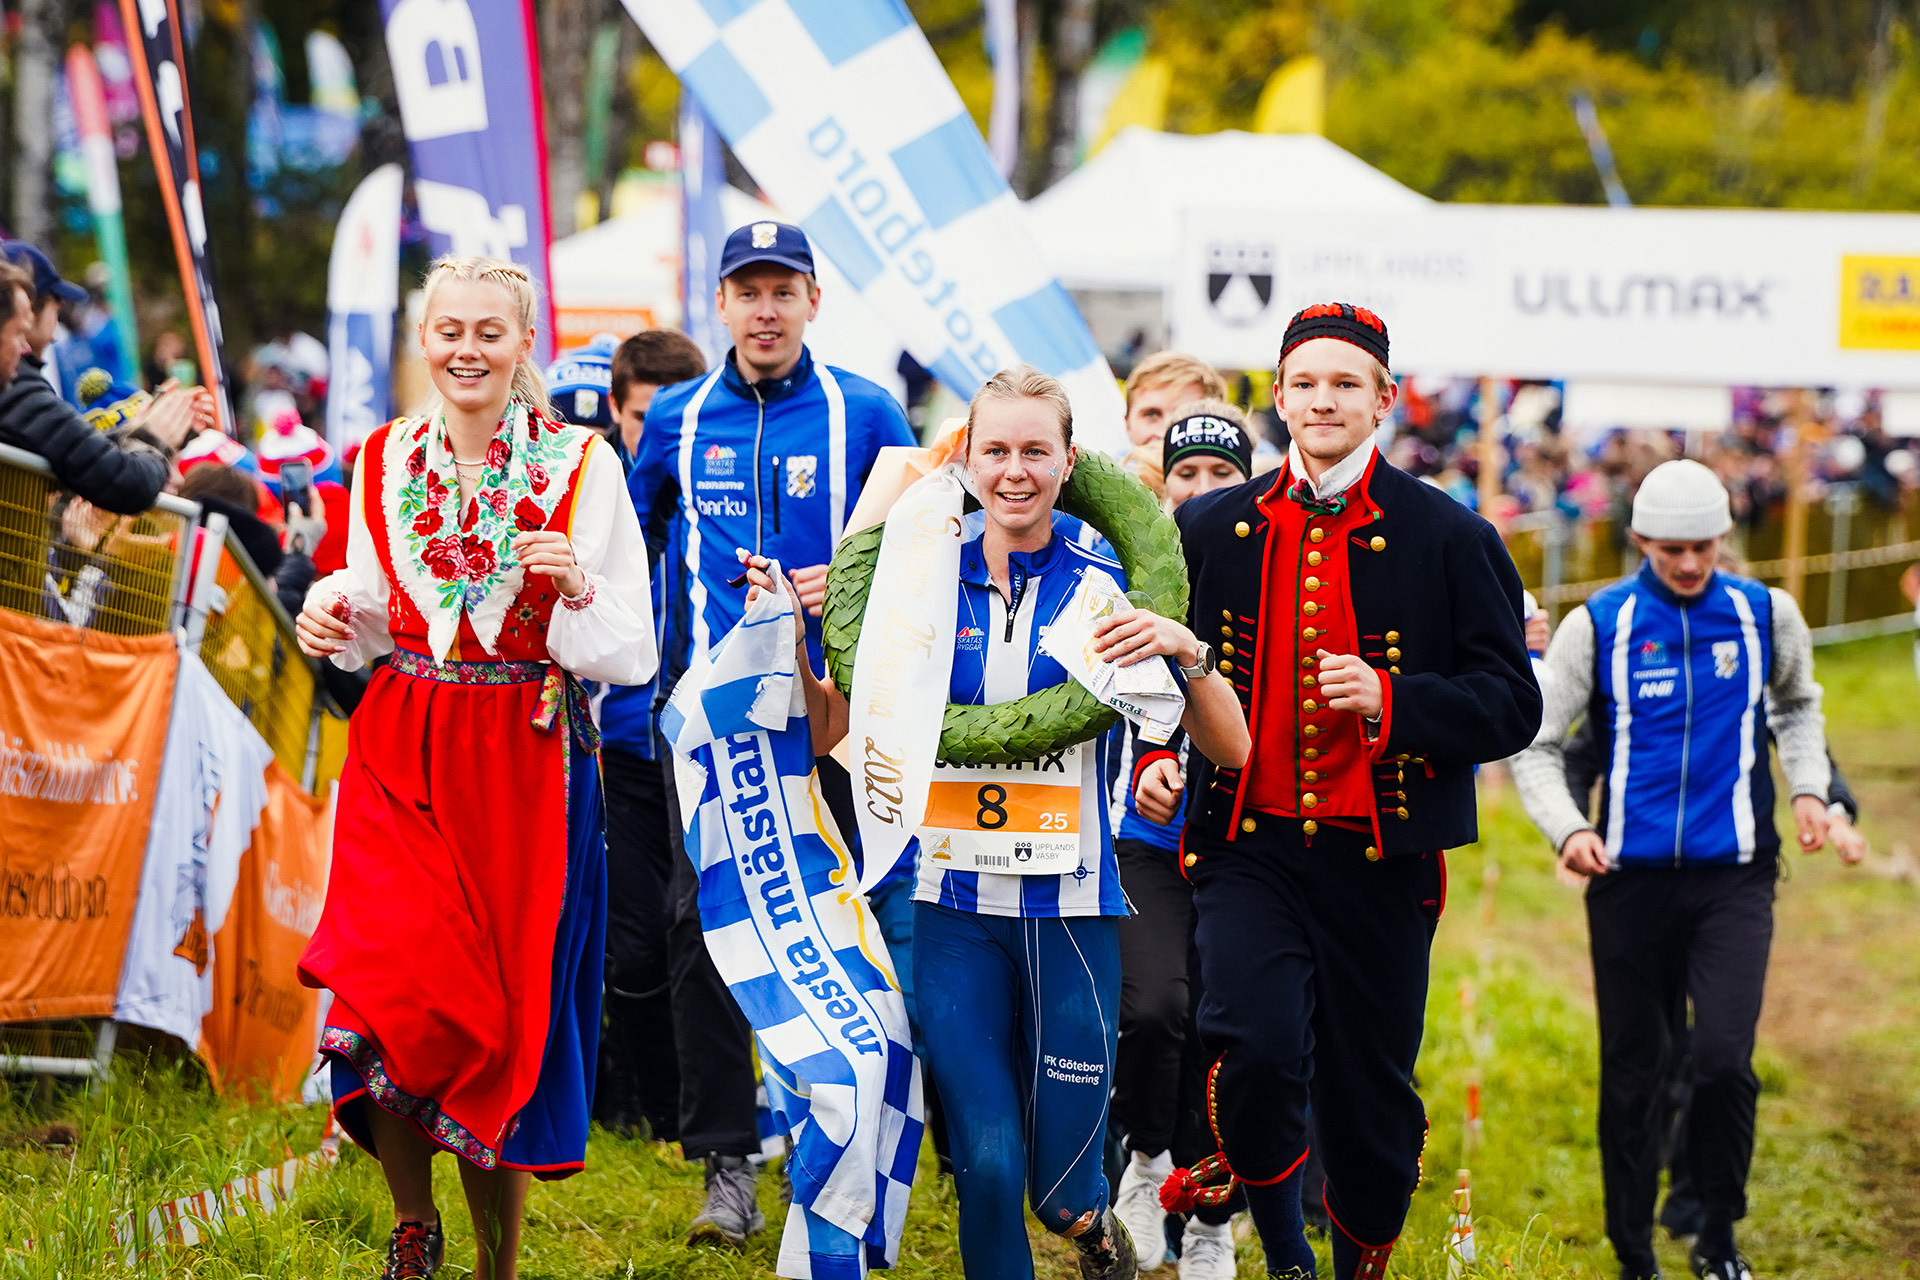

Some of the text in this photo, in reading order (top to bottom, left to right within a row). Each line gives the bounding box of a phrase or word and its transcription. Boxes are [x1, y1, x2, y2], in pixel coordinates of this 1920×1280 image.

[1513, 270, 1770, 319] ULLMAX
[1170, 416, 1240, 447] LEDX
[696, 480, 745, 490] noname
[696, 495, 747, 516] barku
[1109, 697, 1144, 716] PEAB
[863, 735, 906, 828] 2025
[976, 784, 1008, 829] 8
[1039, 813, 1068, 830] 25
[1035, 843, 1075, 851] UPPLANDS
[1035, 851, 1060, 860] VÄSBY
[786, 935, 884, 1057] mesta
[1044, 1054, 1104, 1074] IFK Göteborg
[1046, 1068, 1100, 1086] Orientering
